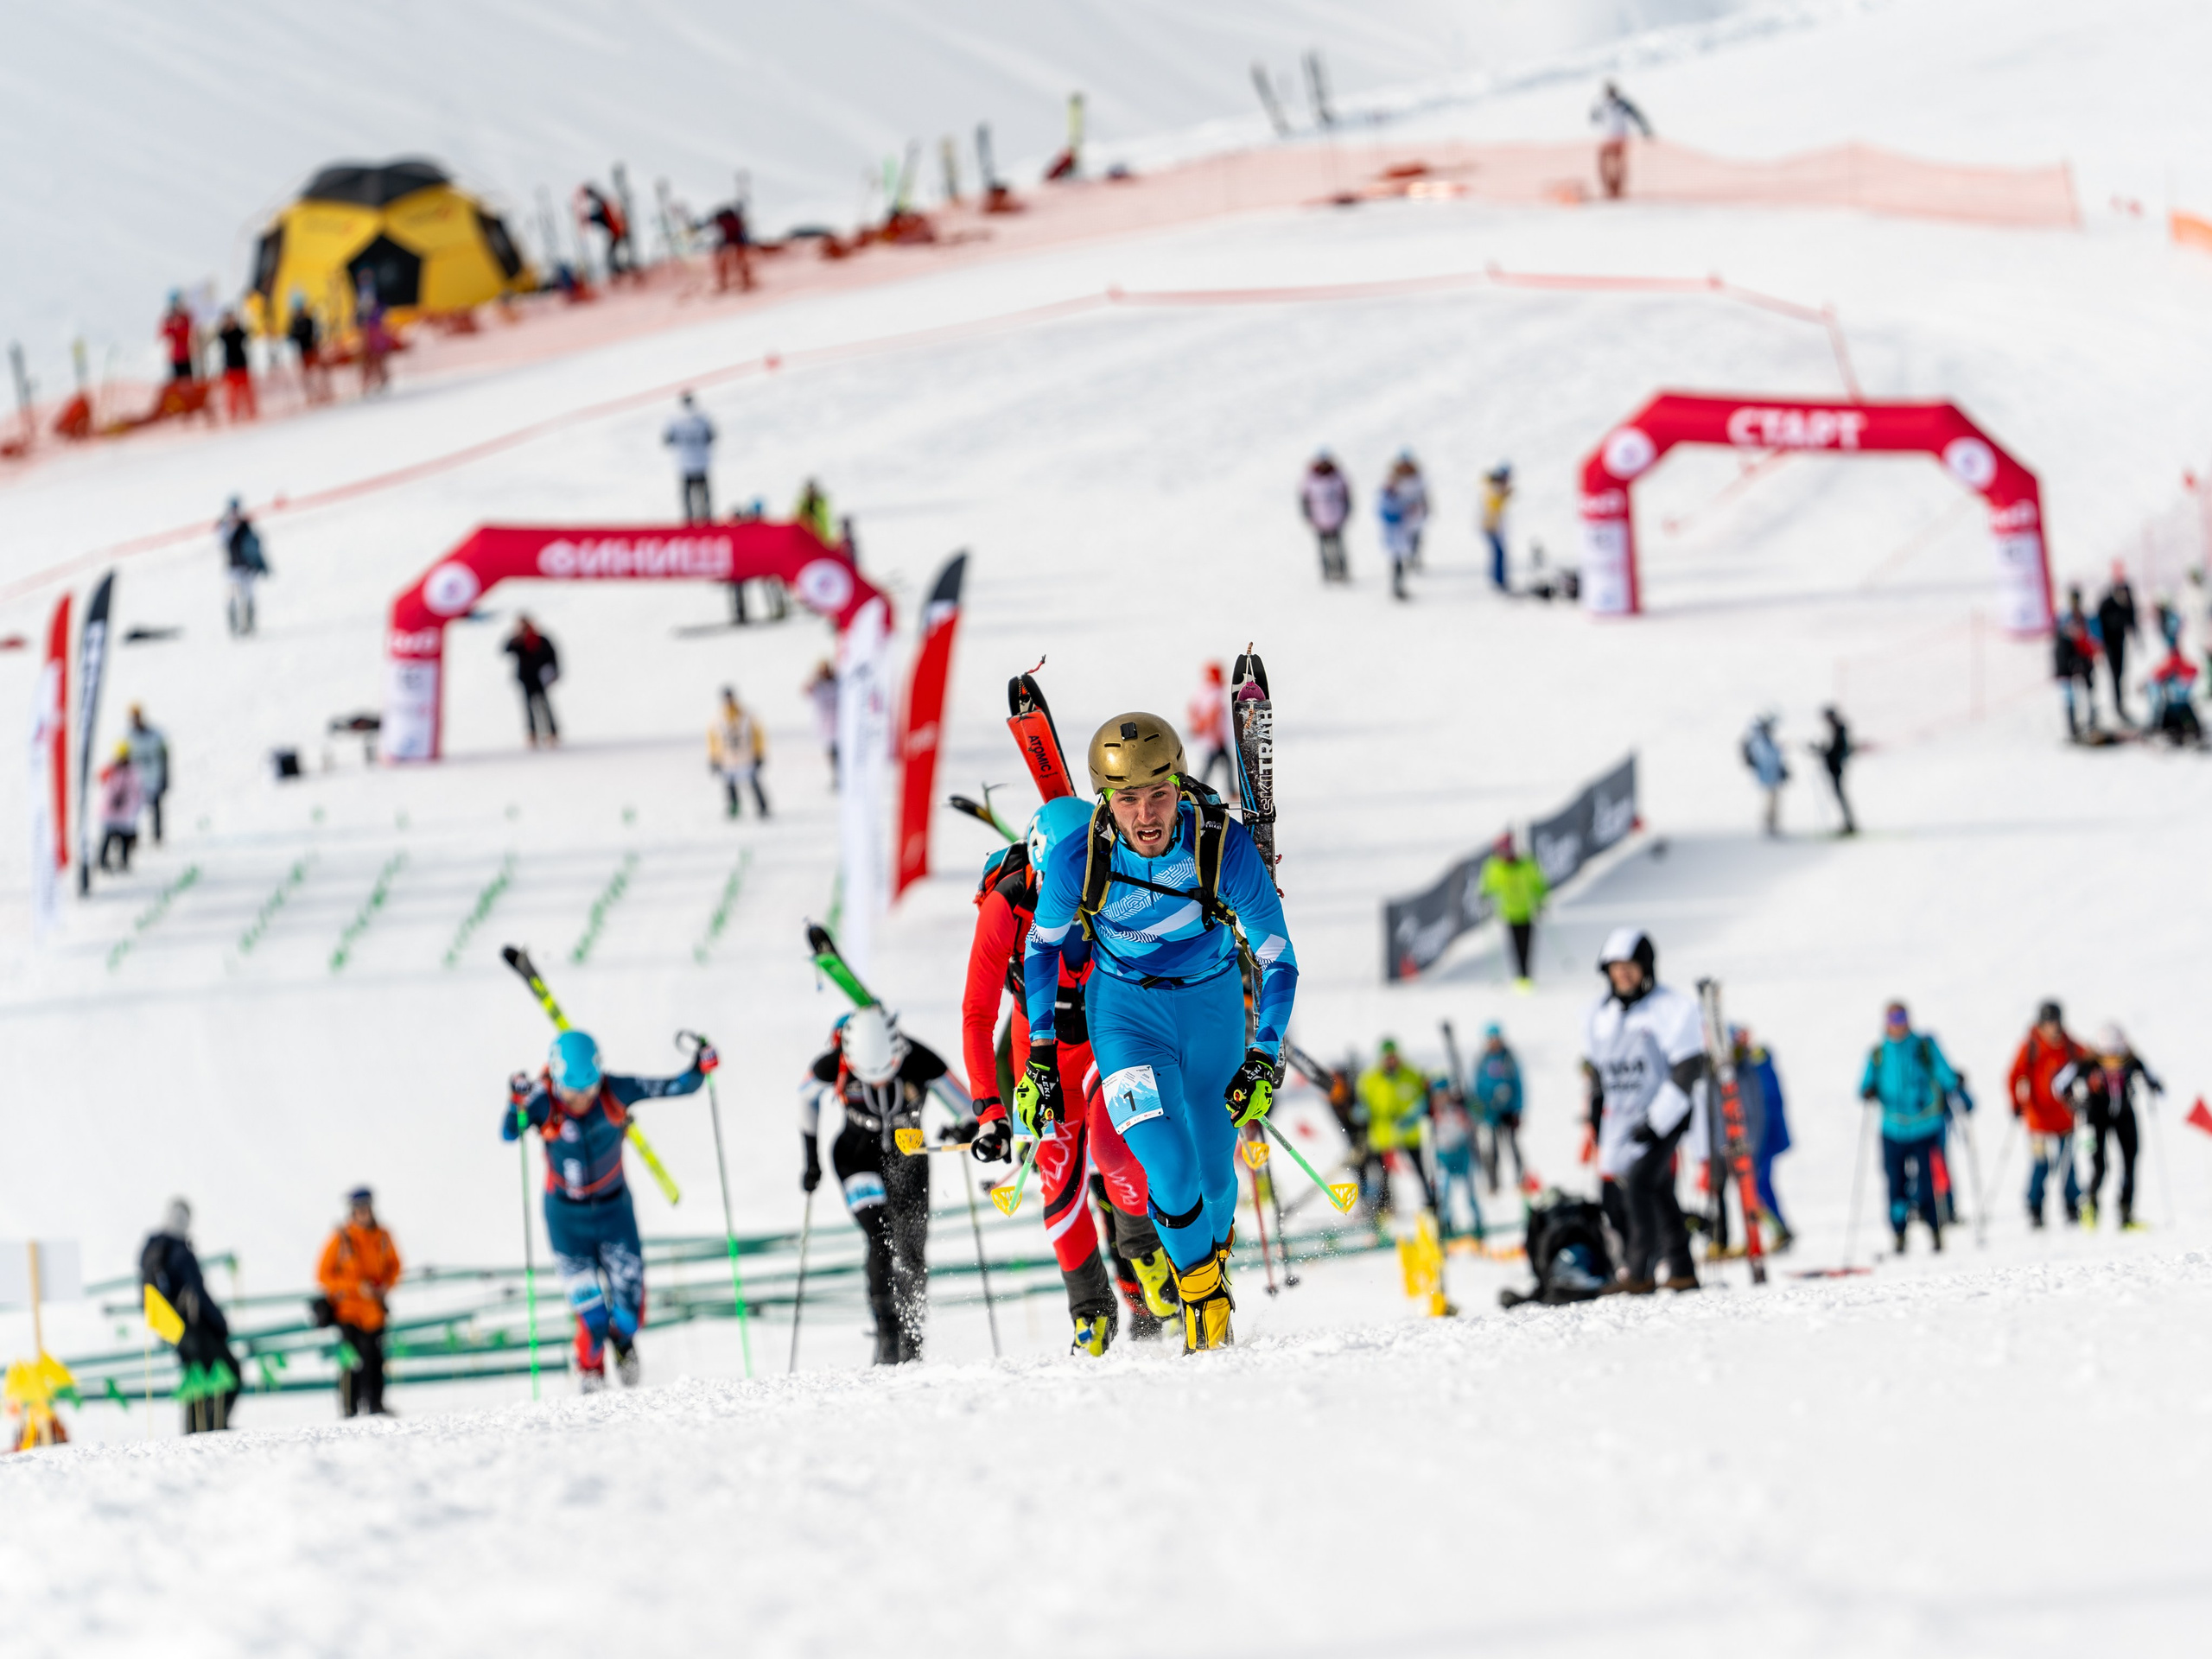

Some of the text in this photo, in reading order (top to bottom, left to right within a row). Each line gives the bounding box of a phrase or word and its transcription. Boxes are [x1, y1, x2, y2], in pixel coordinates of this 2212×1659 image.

[1726, 406, 1868, 451] СТАРТ
[537, 536, 734, 577] ФИНИШ
[1028, 735, 1052, 772] ATOMIC
[1041, 1075, 1051, 1097] LEKI
[1247, 1065, 1262, 1080] LEKI
[1123, 1090, 1136, 1112] 1
